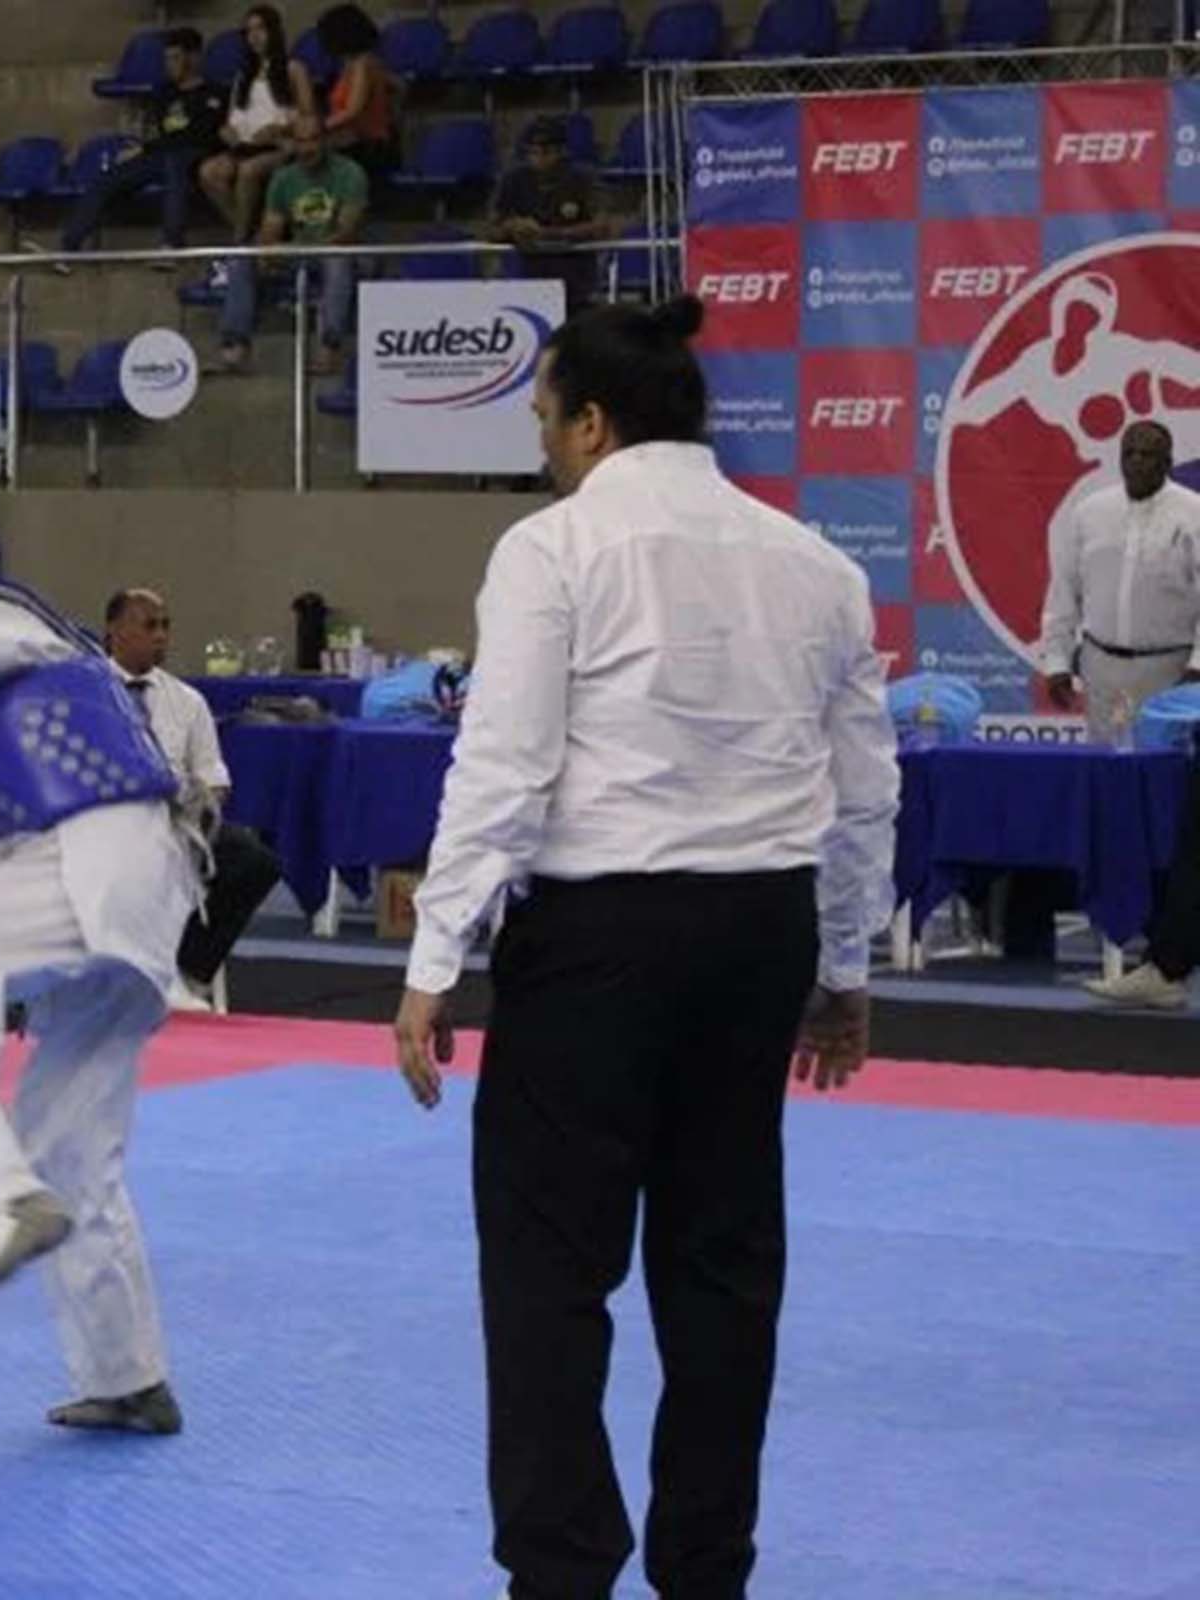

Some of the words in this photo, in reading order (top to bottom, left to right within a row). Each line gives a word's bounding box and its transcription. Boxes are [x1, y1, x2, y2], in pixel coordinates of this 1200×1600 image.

[812, 141, 907, 172] FEBT
[1055, 131, 1159, 162] FEBT
[698, 273, 789, 302] FEBT
[930, 266, 1028, 297] FEBT
[375, 317, 515, 357] sudesb
[811, 397, 905, 427] FEBT
